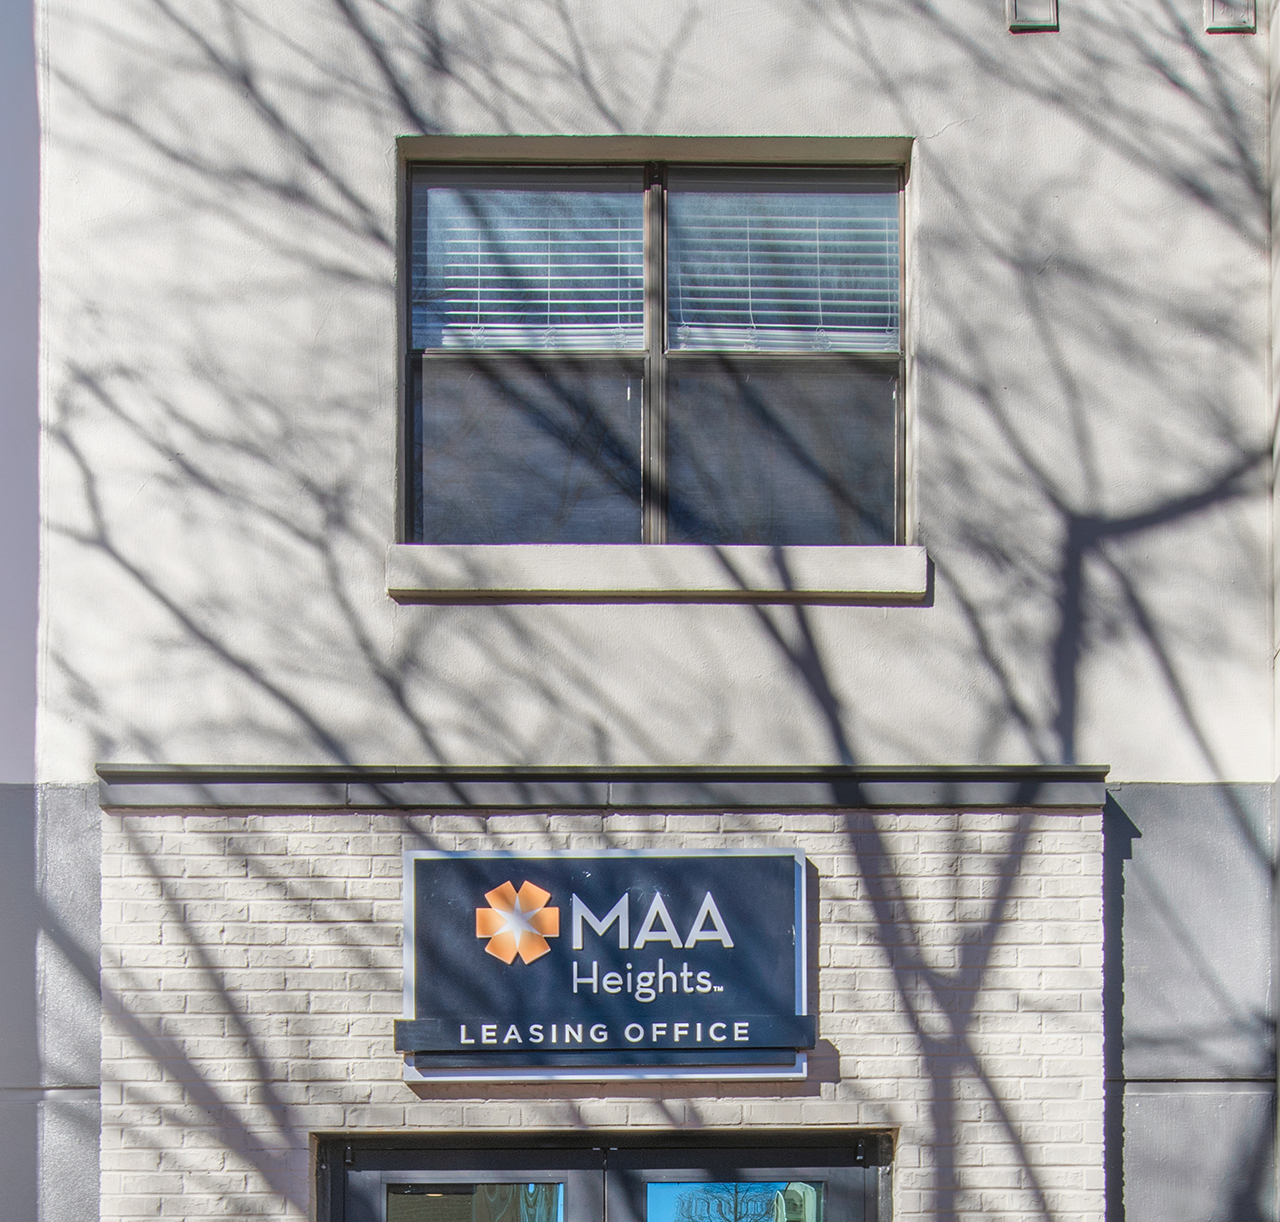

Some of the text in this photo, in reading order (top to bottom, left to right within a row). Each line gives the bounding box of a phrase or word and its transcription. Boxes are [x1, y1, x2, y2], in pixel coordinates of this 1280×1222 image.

[571, 890, 735, 950] MAA
[459, 1021, 750, 1045] LEASING OFFICE
